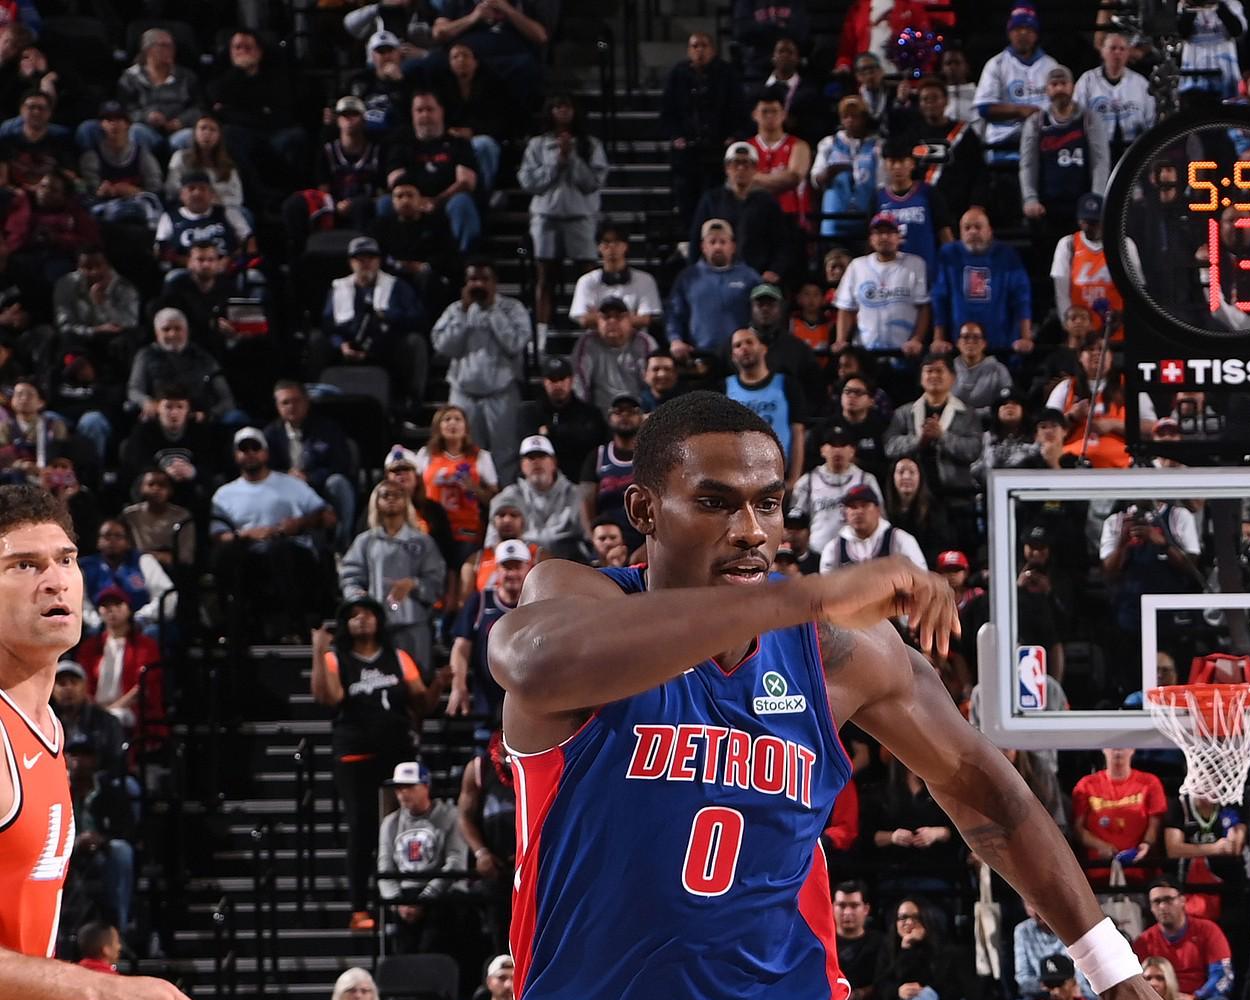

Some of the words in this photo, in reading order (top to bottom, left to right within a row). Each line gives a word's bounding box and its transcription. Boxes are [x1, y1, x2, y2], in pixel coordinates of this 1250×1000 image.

[1056, 148, 1085, 168] 84
[755, 698, 805, 713] StockX
[625, 723, 817, 809] DETROIT
[680, 805, 745, 897] 0
